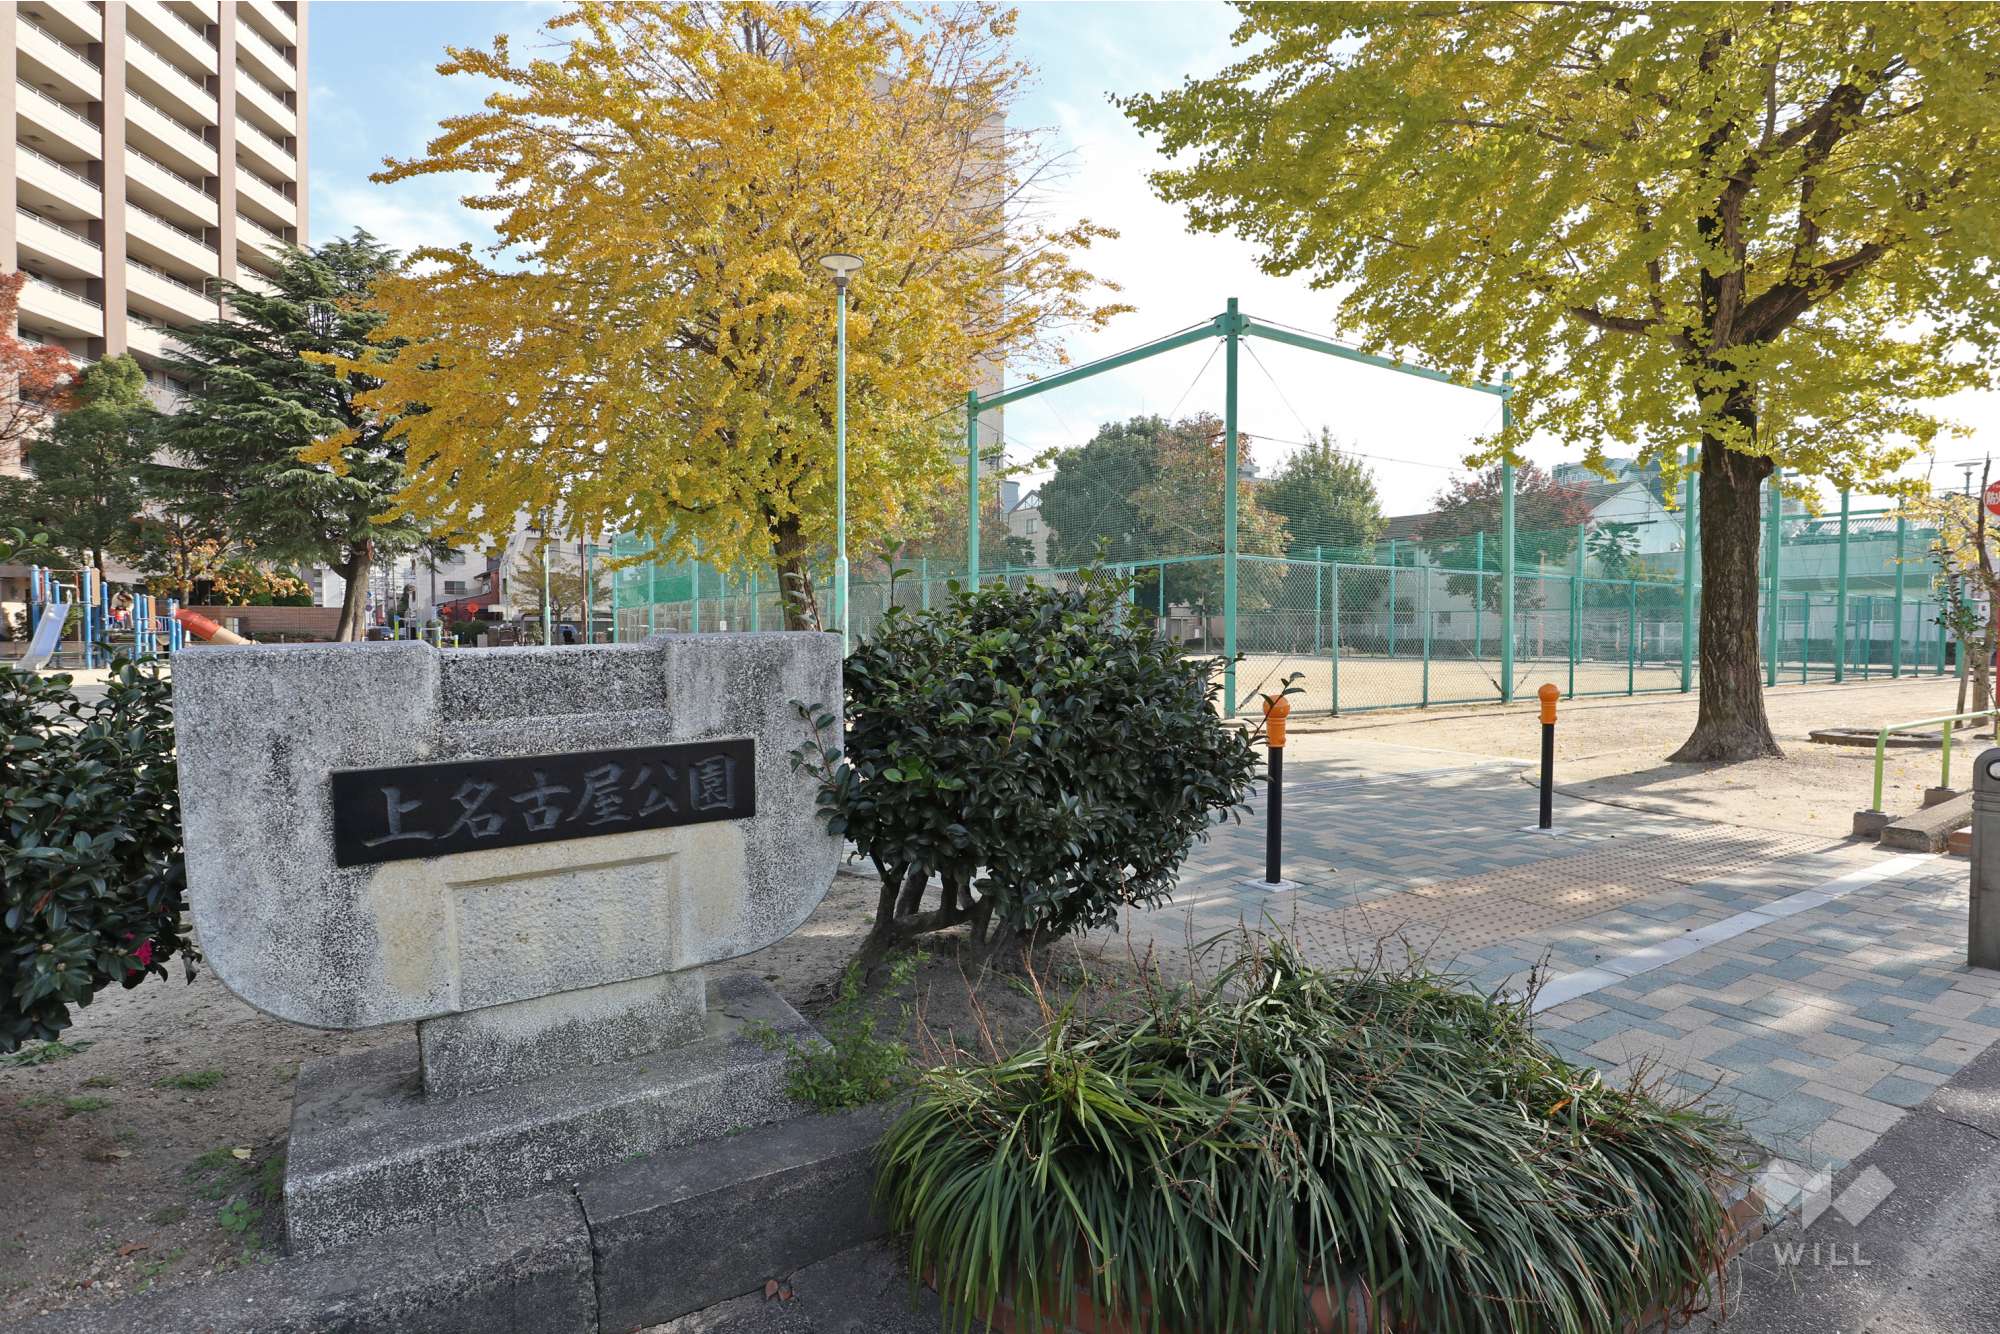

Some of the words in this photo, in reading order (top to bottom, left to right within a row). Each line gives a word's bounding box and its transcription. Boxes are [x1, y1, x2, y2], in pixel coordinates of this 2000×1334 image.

[361, 752, 737, 848] 上名古屋公園
